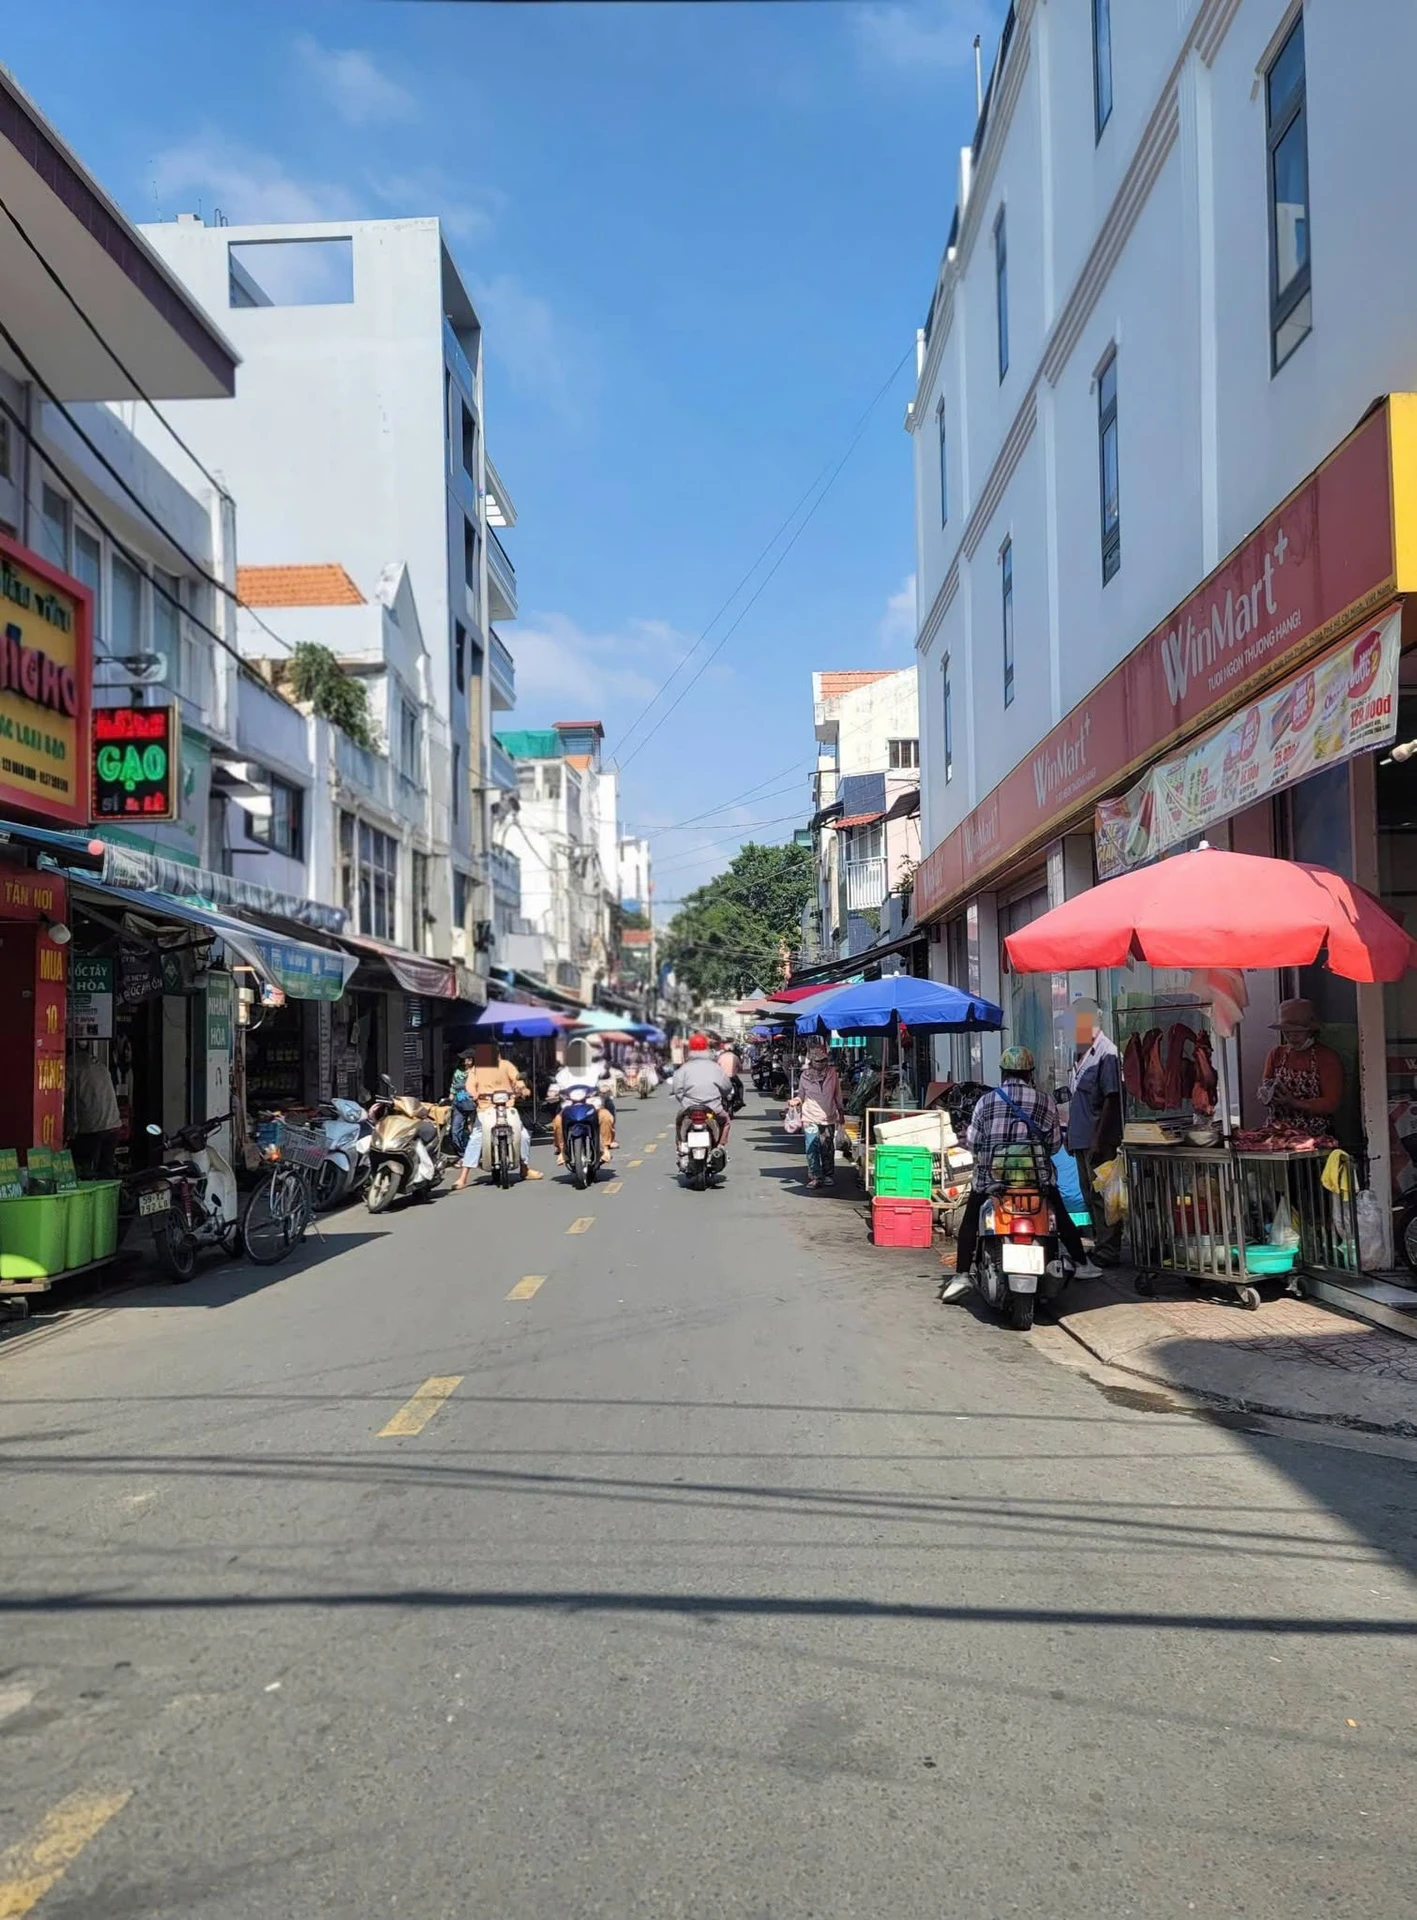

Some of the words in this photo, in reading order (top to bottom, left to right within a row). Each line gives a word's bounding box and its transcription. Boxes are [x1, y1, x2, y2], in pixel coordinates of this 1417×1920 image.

[98, 743, 165, 791] GẠO
[40, 949, 63, 981] MUA
[77, 979, 106, 991] HÒA
[46, 1005, 57, 1035] 10
[42, 1114, 56, 1145] 01
